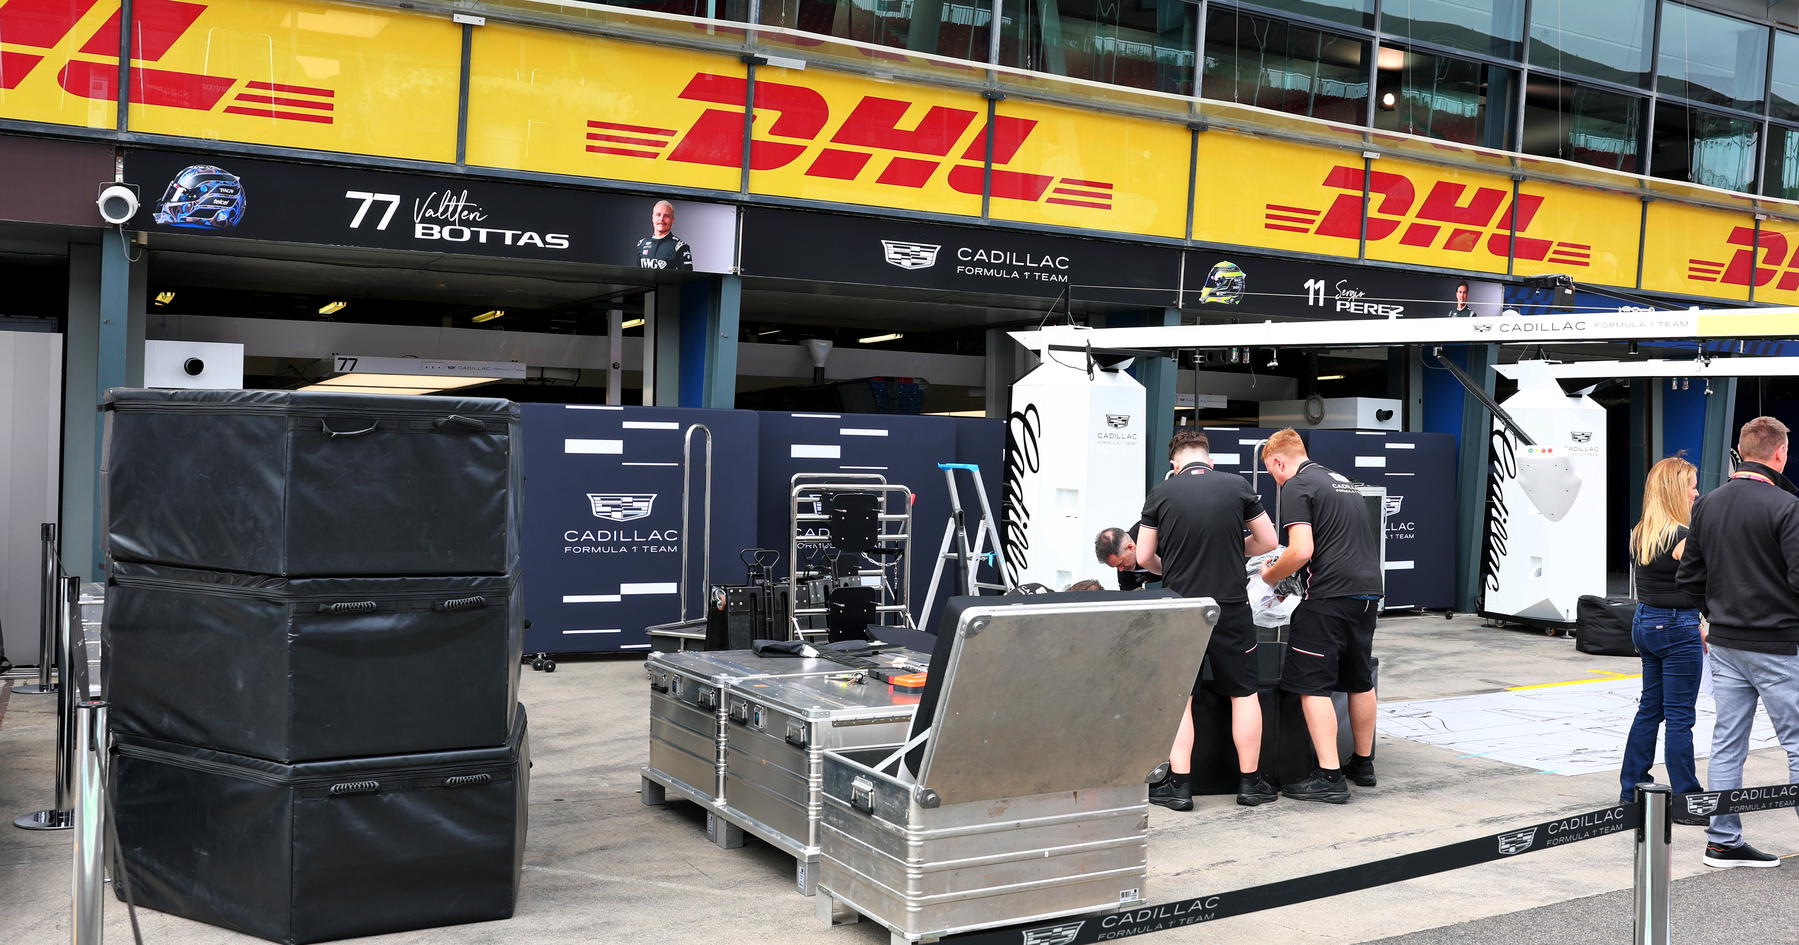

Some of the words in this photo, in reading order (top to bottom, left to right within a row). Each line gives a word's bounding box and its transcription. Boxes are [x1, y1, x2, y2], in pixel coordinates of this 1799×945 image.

[666, 72, 1054, 201] DHL
[345, 190, 401, 231] 77
[1314, 165, 1553, 261] DHL
[414, 223, 570, 249] BOTTAS
[957, 247, 1070, 270] CADILLAC
[956, 266, 1020, 279] FORMULA
[1023, 271, 1031, 279] 1
[1034, 272, 1068, 283] TEAM
[1303, 278, 1325, 307] 11
[1334, 279, 1366, 301] Sergio
[1499, 321, 1586, 333] CADILLAC
[1593, 321, 1646, 329] FORMULA
[1658, 320, 1689, 328] TEAM
[337, 357, 358, 371] 77
[1097, 432, 1137, 440] CADILLAC
[564, 530, 678, 542] CADILLAC
[564, 546, 628, 554] FORMULA
[642, 545, 678, 553] TEAM
[1730, 785, 1799, 802] CADILLAC
[1729, 802, 1767, 813] FORMULA
[1775, 800, 1796, 809] TEAM
[1547, 807, 1625, 835] CADILLAC
[1546, 831, 1590, 847] FORMULA
[1599, 823, 1623, 837] TEAM
[1101, 896, 1220, 929] CADILLAC
[1097, 922, 1163, 941] FORMULA
[1179, 912, 1215, 926] TEAM
